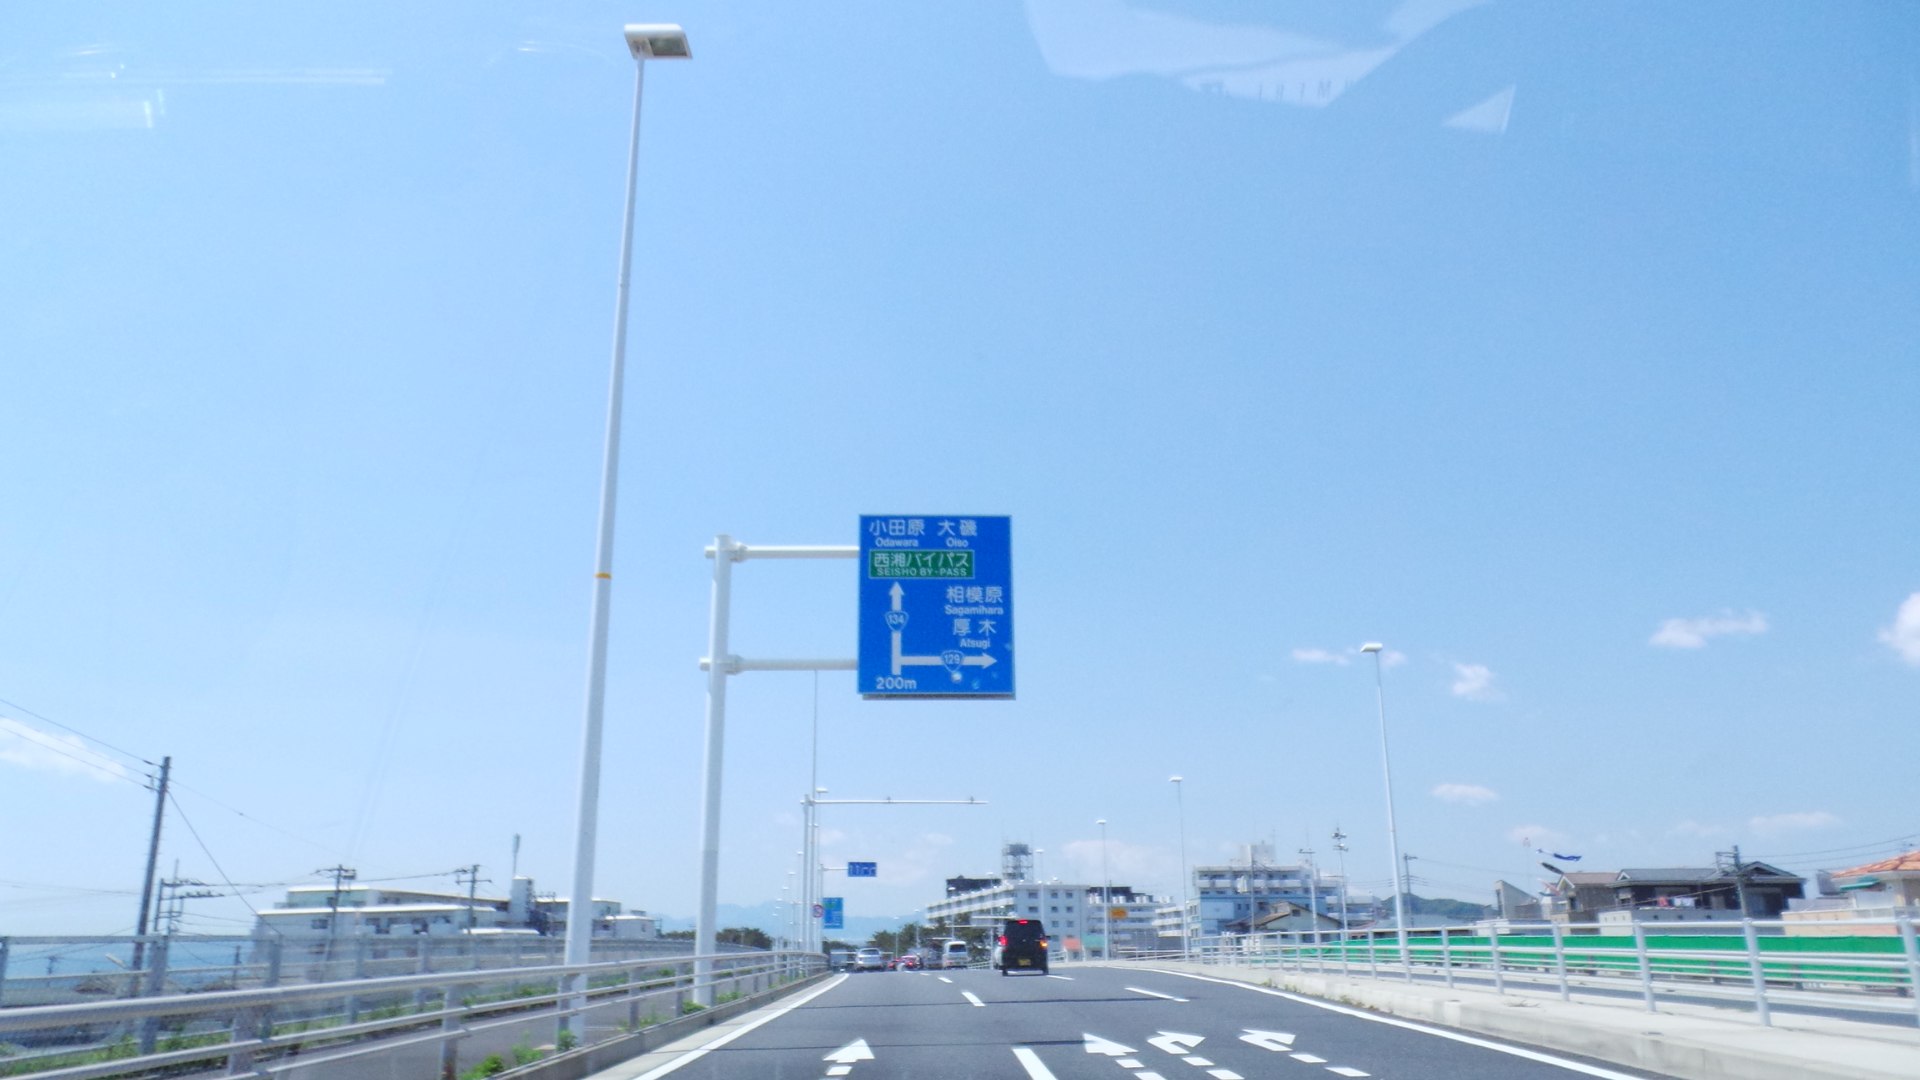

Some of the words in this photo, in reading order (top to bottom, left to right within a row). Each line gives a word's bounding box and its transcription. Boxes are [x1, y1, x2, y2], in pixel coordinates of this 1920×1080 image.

[869, 520, 925, 536] 小田原
[938, 519, 977, 536] 大磯
[876, 537, 919, 547] Odawara
[946, 537, 968, 548] Oiso
[874, 552, 969, 567] 西湘バイパス
[877, 567, 917, 576] SEISHO
[947, 587, 1003, 604] 相模原
[945, 605, 1003, 616] Sagamihara
[888, 614, 904, 625] 134
[953, 618, 997, 636] 厚木
[960, 639, 991, 650] Atsugi
[944, 654, 960, 665] 129
[876, 677, 917, 690] 200m
